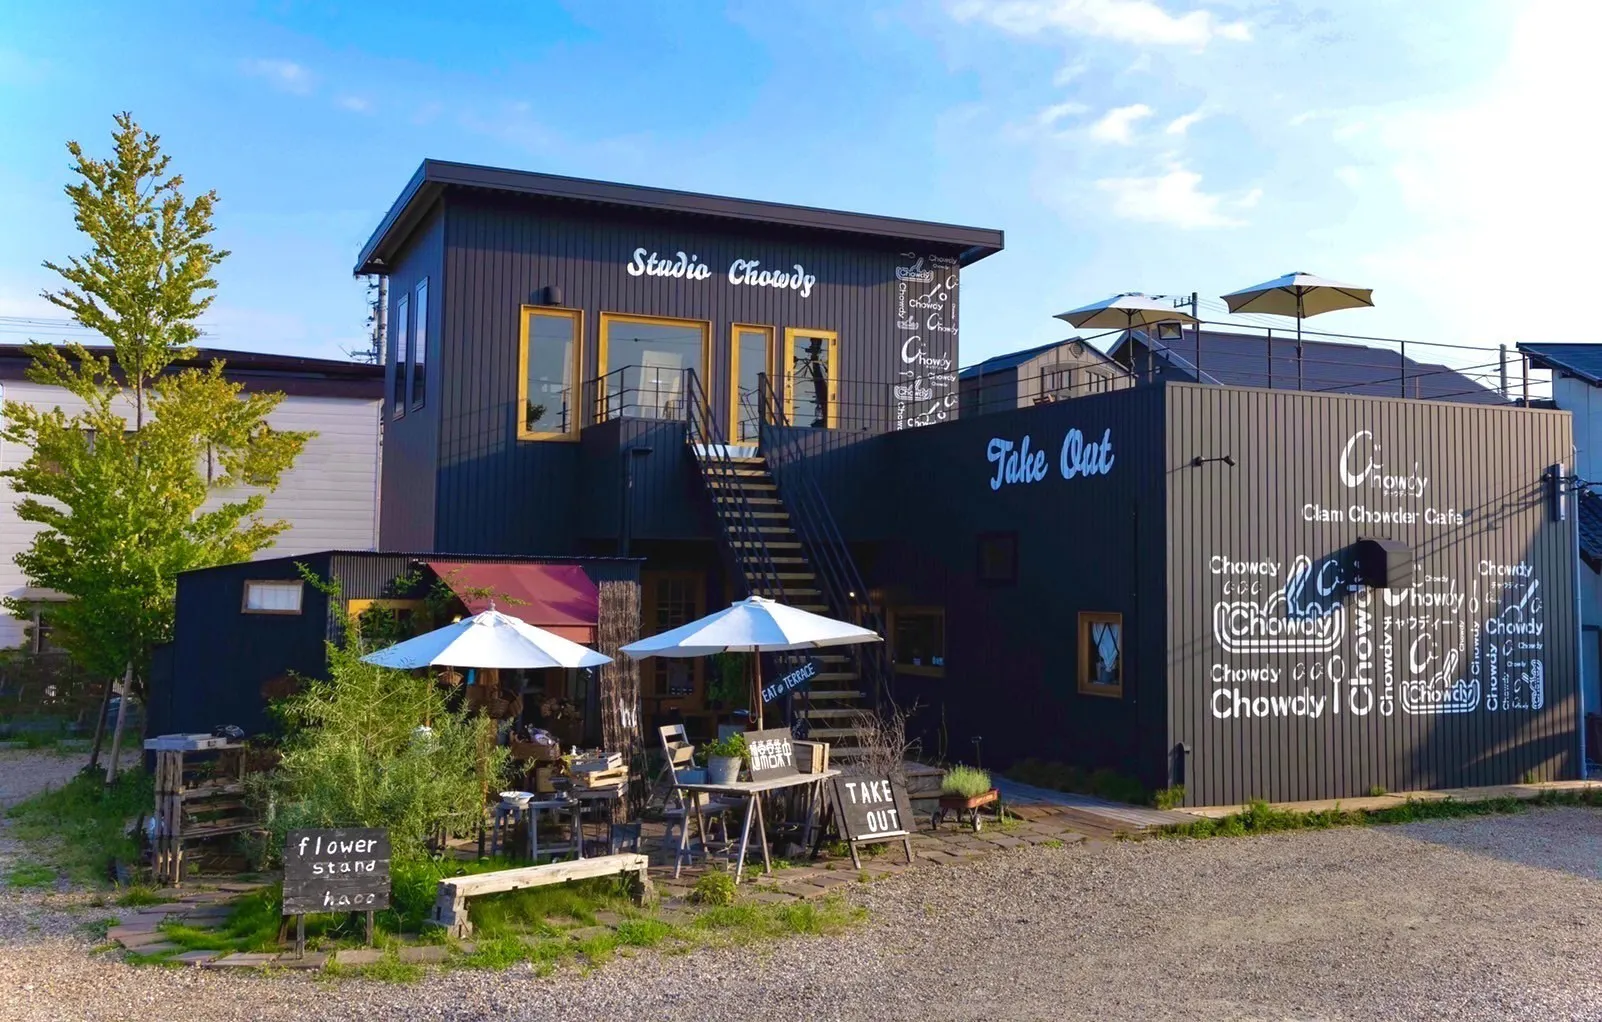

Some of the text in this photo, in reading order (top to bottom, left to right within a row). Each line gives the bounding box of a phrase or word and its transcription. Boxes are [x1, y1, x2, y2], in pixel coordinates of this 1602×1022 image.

[627, 247, 816, 298] Studio Chowdy
[898, 282, 907, 319] Chowdy
[909, 299, 944, 311] Chowdy
[901, 335, 952, 370] Chowdy
[987, 427, 1115, 491] Take Out
[1339, 429, 1429, 498] Chowdy
[1301, 503, 1464, 525] Clam Chowder Cafe
[1209, 555, 1281, 577] Chowdy
[1478, 559, 1533, 578] Chowdy
[1229, 608, 1333, 639] Chowdy
[1383, 614, 1454, 631] チャウディー
[1485, 617, 1543, 636] Chowdy
[761, 684, 777, 703] EAT
[782, 662, 816, 690] TERRACE
[1209, 663, 1282, 683] Chowdy
[1380, 632, 1394, 716] Chowdy
[1486, 642, 1498, 711] Chowdy
[1209, 686, 1328, 719] Chowdy
[1408, 684, 1474, 704] Chowdy
[845, 780, 893, 804] TAKE
[866, 809, 898, 833] OUT
[298, 836, 378, 856] flower
[312, 859, 376, 875] stand
